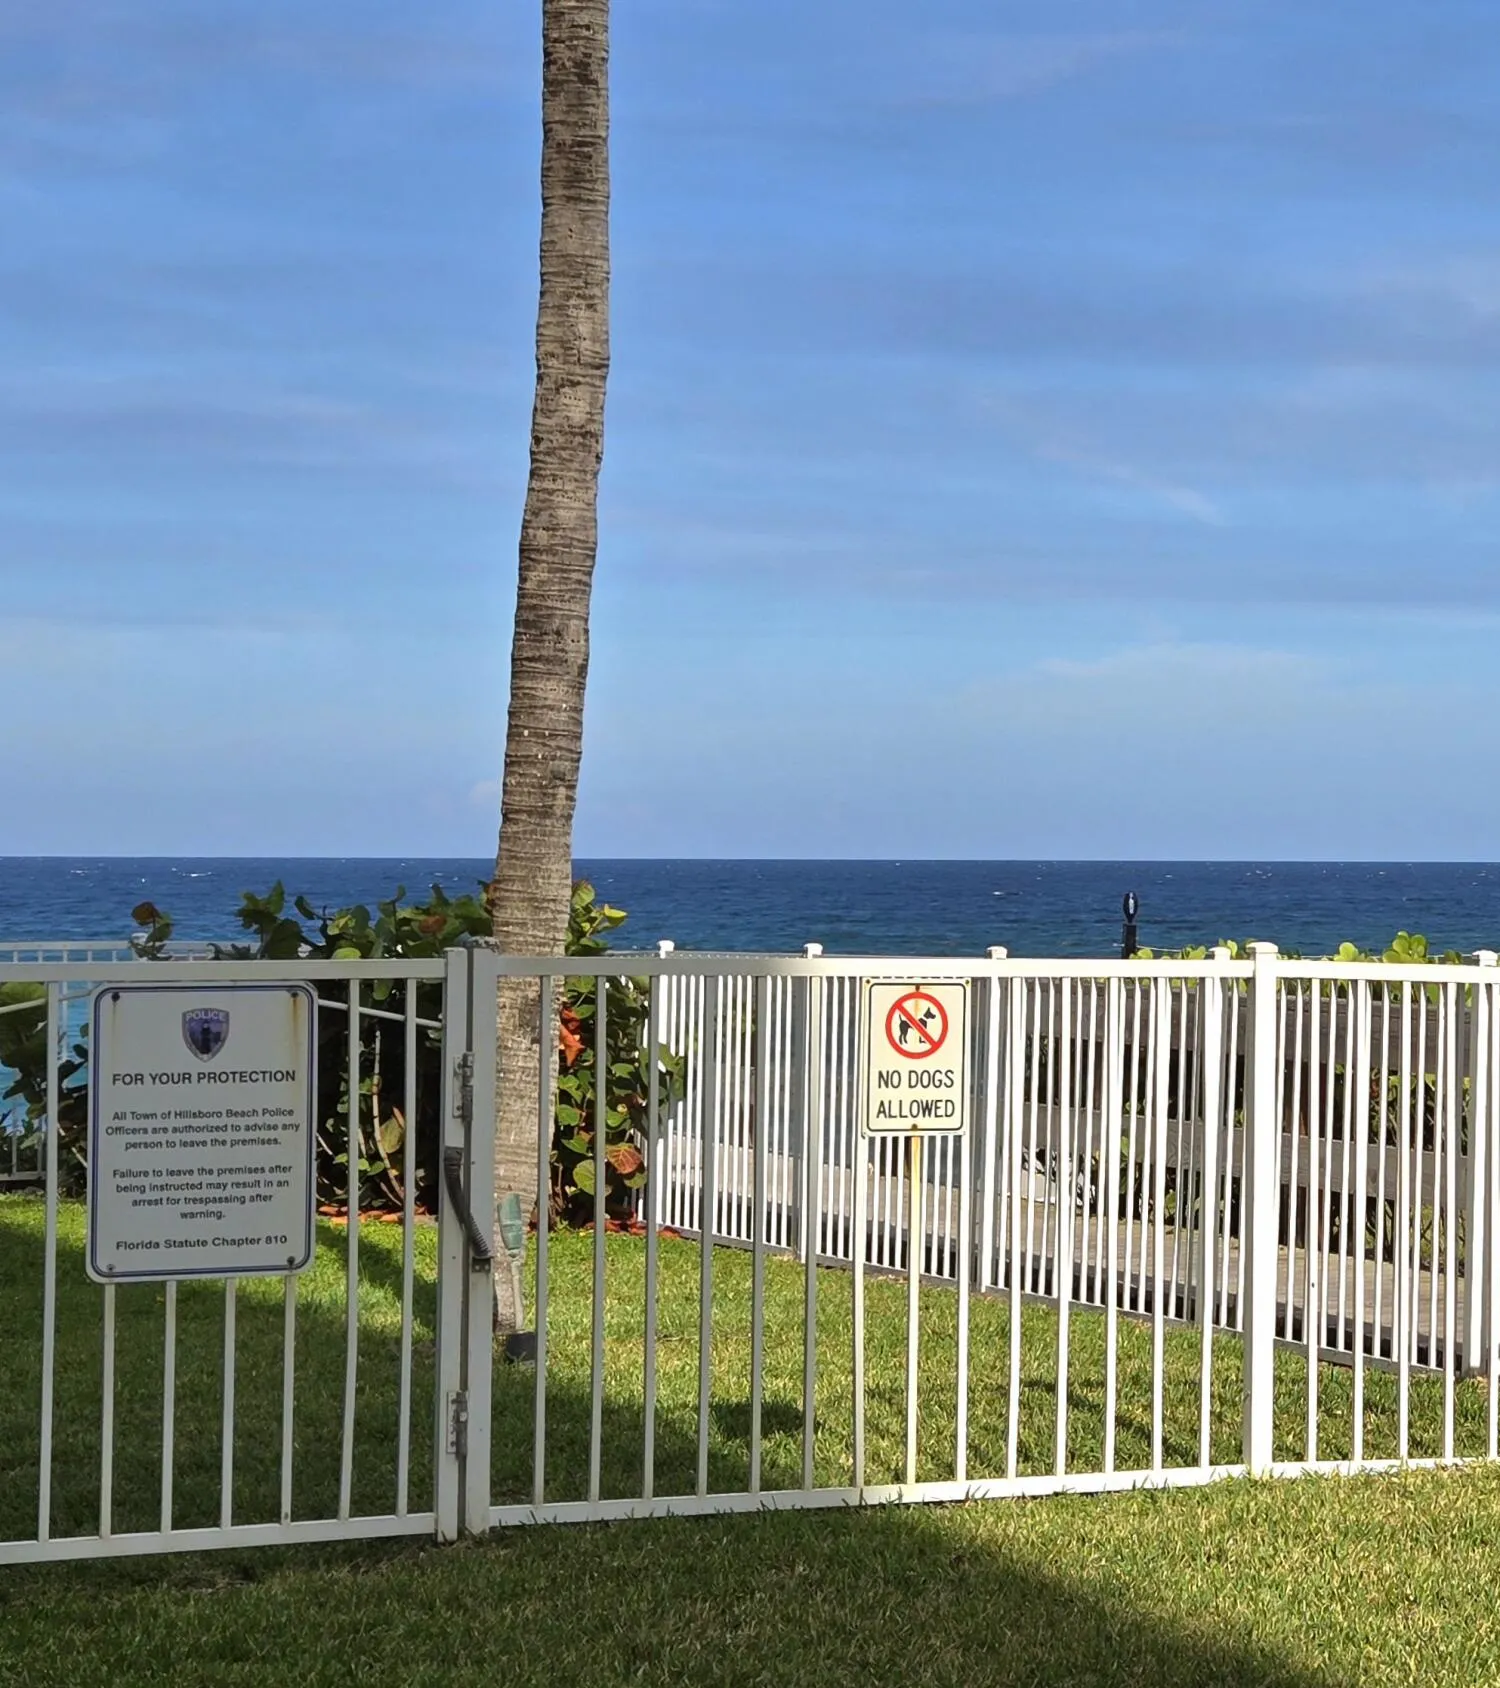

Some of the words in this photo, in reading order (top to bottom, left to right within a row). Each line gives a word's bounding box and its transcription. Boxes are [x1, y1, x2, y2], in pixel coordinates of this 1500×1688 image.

[186, 1010, 226, 1021] POLICE
[112, 1073, 144, 1086] FOR
[149, 1073, 192, 1085] YOUR
[197, 1070, 295, 1084] PROTECTION
[878, 1070, 901, 1088] NO
[908, 1070, 954, 1088] DOGS
[112, 1112, 126, 1121] All
[129, 1111, 157, 1120] Town
[160, 1110, 171, 1119] of
[174, 1109, 222, 1119] Hillsboro
[226, 1109, 259, 1118] Beach
[262, 1108, 294, 1117] Police
[876, 1100, 955, 1119] ALLOWED
[106, 1126, 148, 1135] Officers
[172, 1124, 227, 1134] authorized
[231, 1124, 241, 1132] to
[244, 1122, 278, 1132] advise
[281, 1123, 300, 1132] any
[125, 1140, 162, 1151] person
[165, 1140, 176, 1148] to
[179, 1138, 207, 1148] leave
[210, 1137, 227, 1146] the
[230, 1136, 281, 1148] premises.
[113, 1169, 149, 1178] Failure
[152, 1169, 162, 1177] to
[166, 1167, 194, 1177] leave
[197, 1166, 214, 1176] the
[217, 1166, 265, 1177] premises
[268, 1165, 292, 1174] after
[116, 1184, 146, 1194] being
[149, 1182, 202, 1191] instructed
[206, 1182, 227, 1191] may
[231, 1180, 260, 1189] result
[264, 1179, 273, 1188] in
[276, 1180, 289, 1188] an
[132, 1198, 163, 1206] arrest
[166, 1196, 181, 1206] for
[184, 1194, 246, 1206] trespassing
[249, 1194, 273, 1203] after
[180, 1210, 226, 1220] warning.
[116, 1240, 160, 1251] Florida
[164, 1238, 208, 1249] Statute
[212, 1237, 261, 1248] Chapter
[265, 1235, 287, 1245] 810
